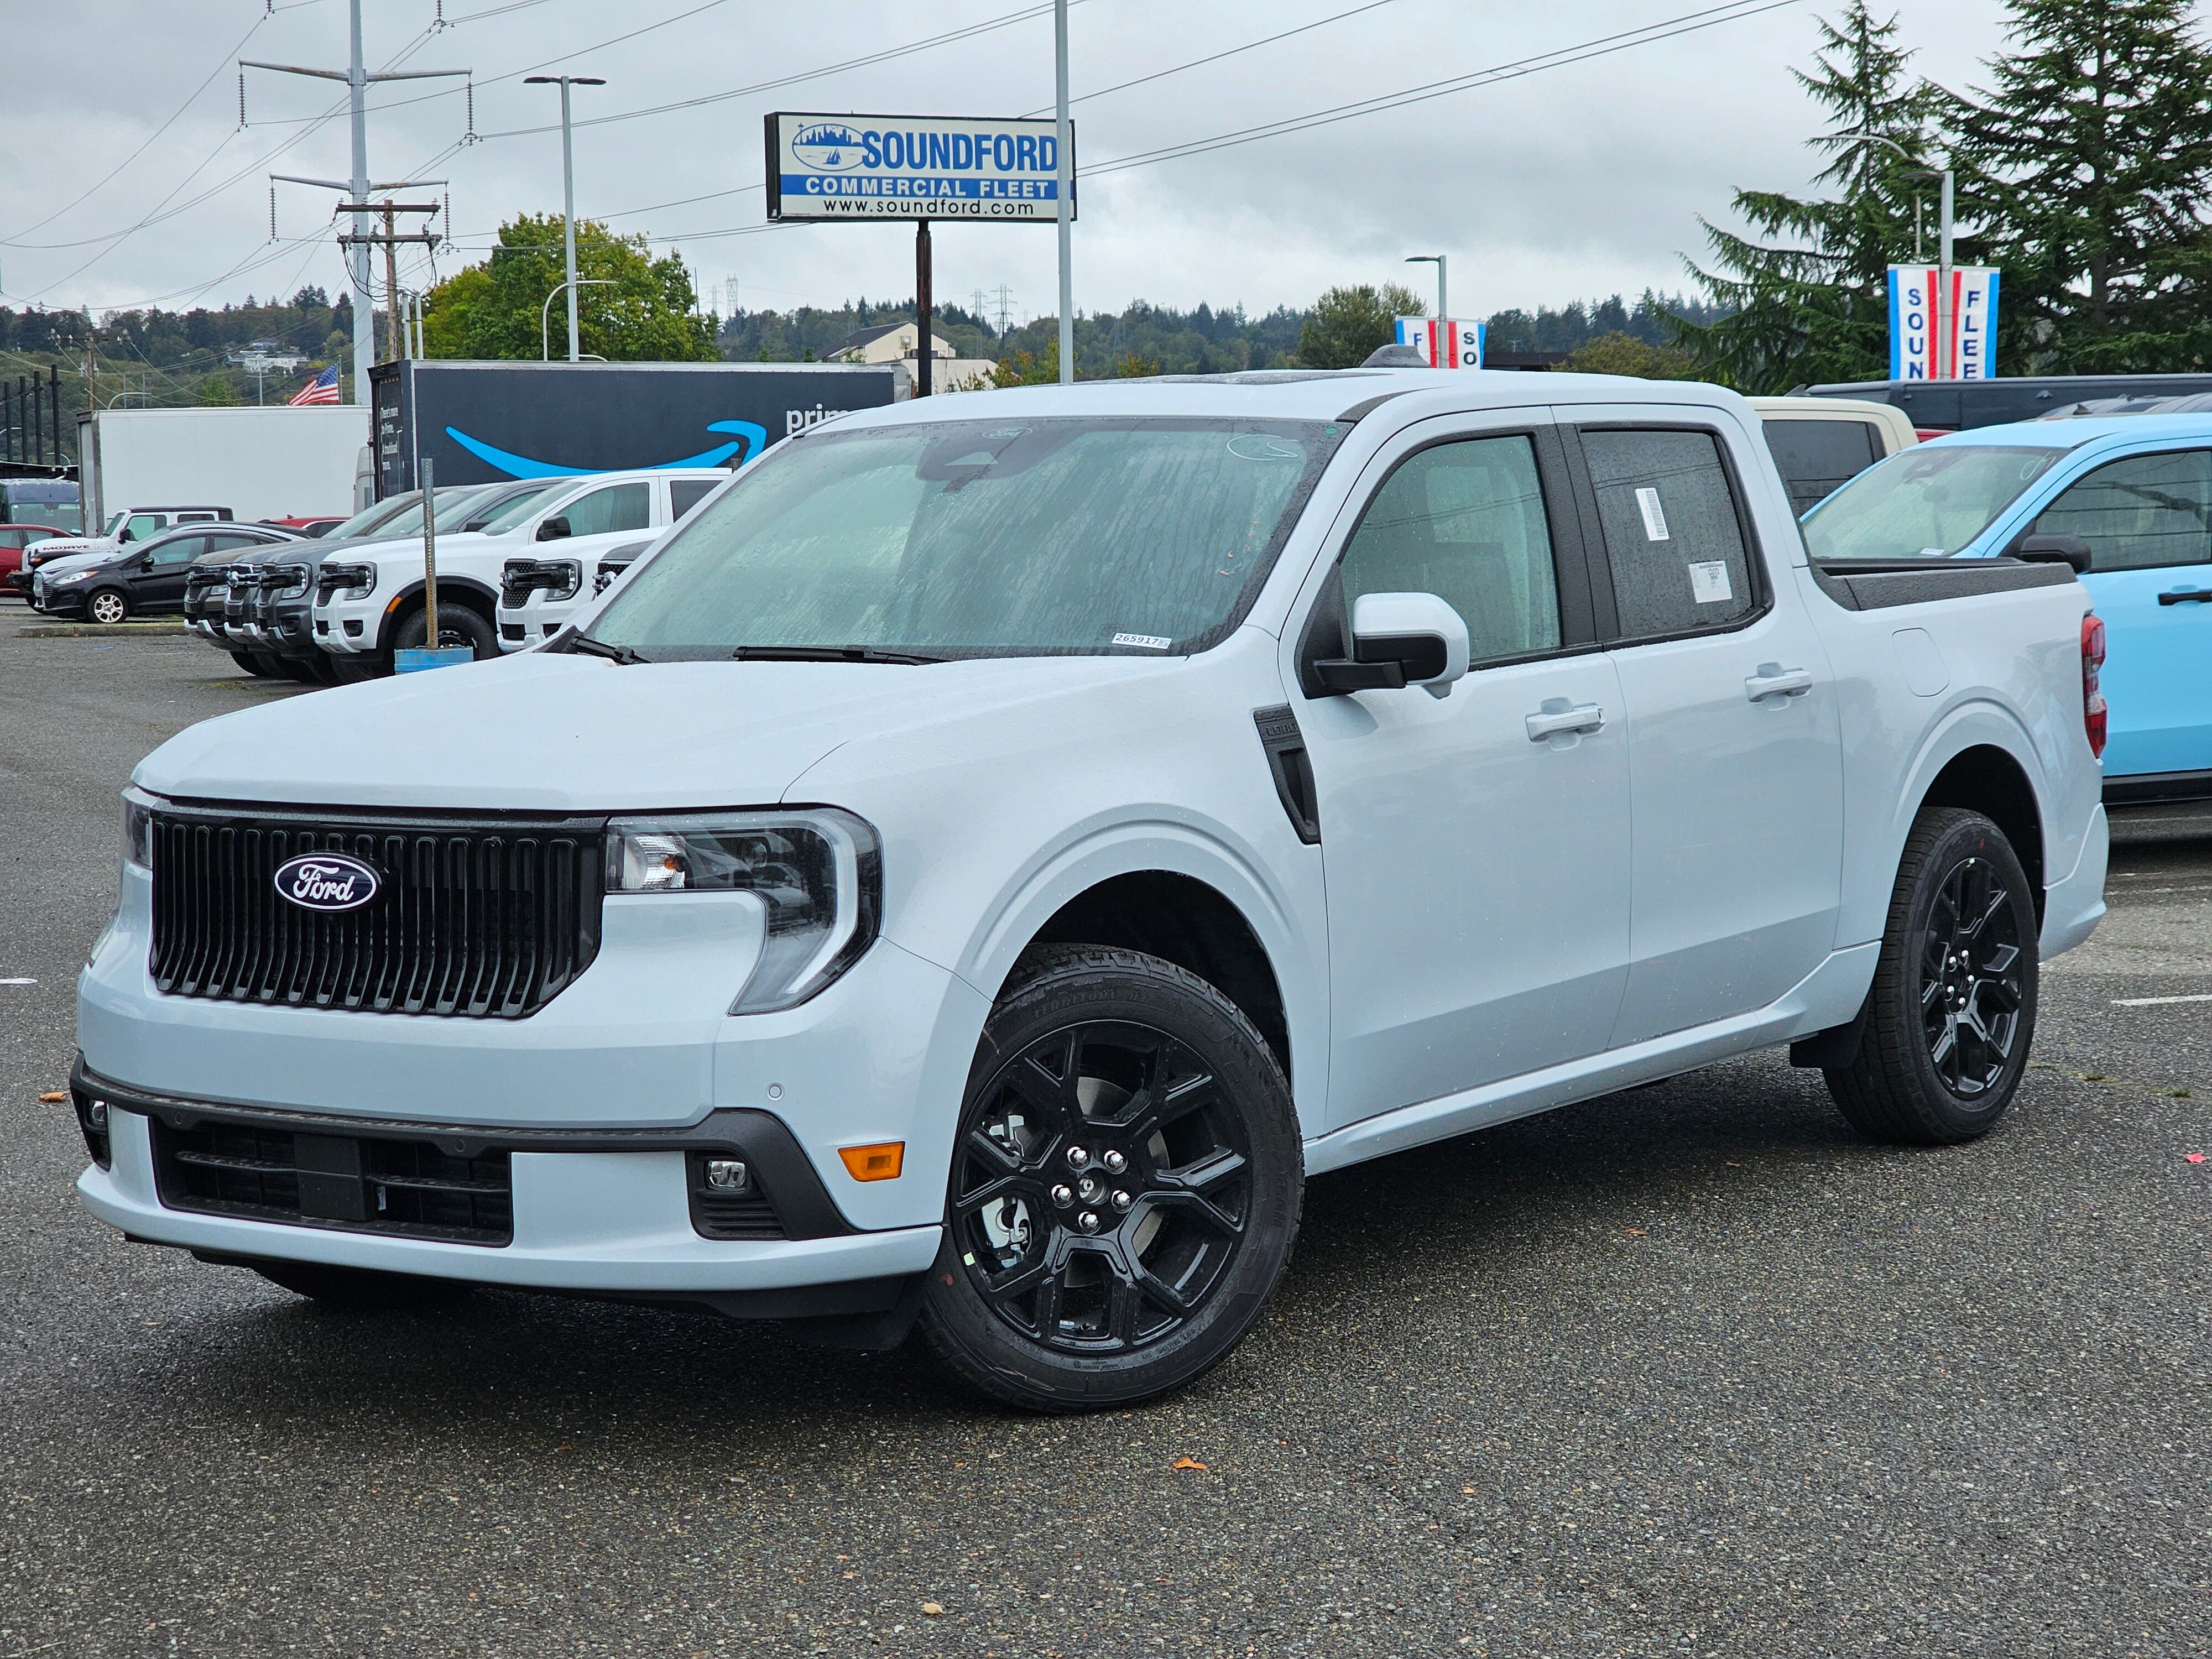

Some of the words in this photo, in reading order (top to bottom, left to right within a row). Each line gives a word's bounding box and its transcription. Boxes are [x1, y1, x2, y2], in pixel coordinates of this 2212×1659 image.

[862, 130, 1057, 171] SOUNDFORD
[806, 178, 967, 196] COMMERCIAL
[980, 180, 1050, 197] FLEET
[823, 199, 1034, 215] www.soundford.com
[786, 403, 849, 434] pri
[1115, 634, 1159, 645] 265917
[293, 864, 356, 901] Ford
